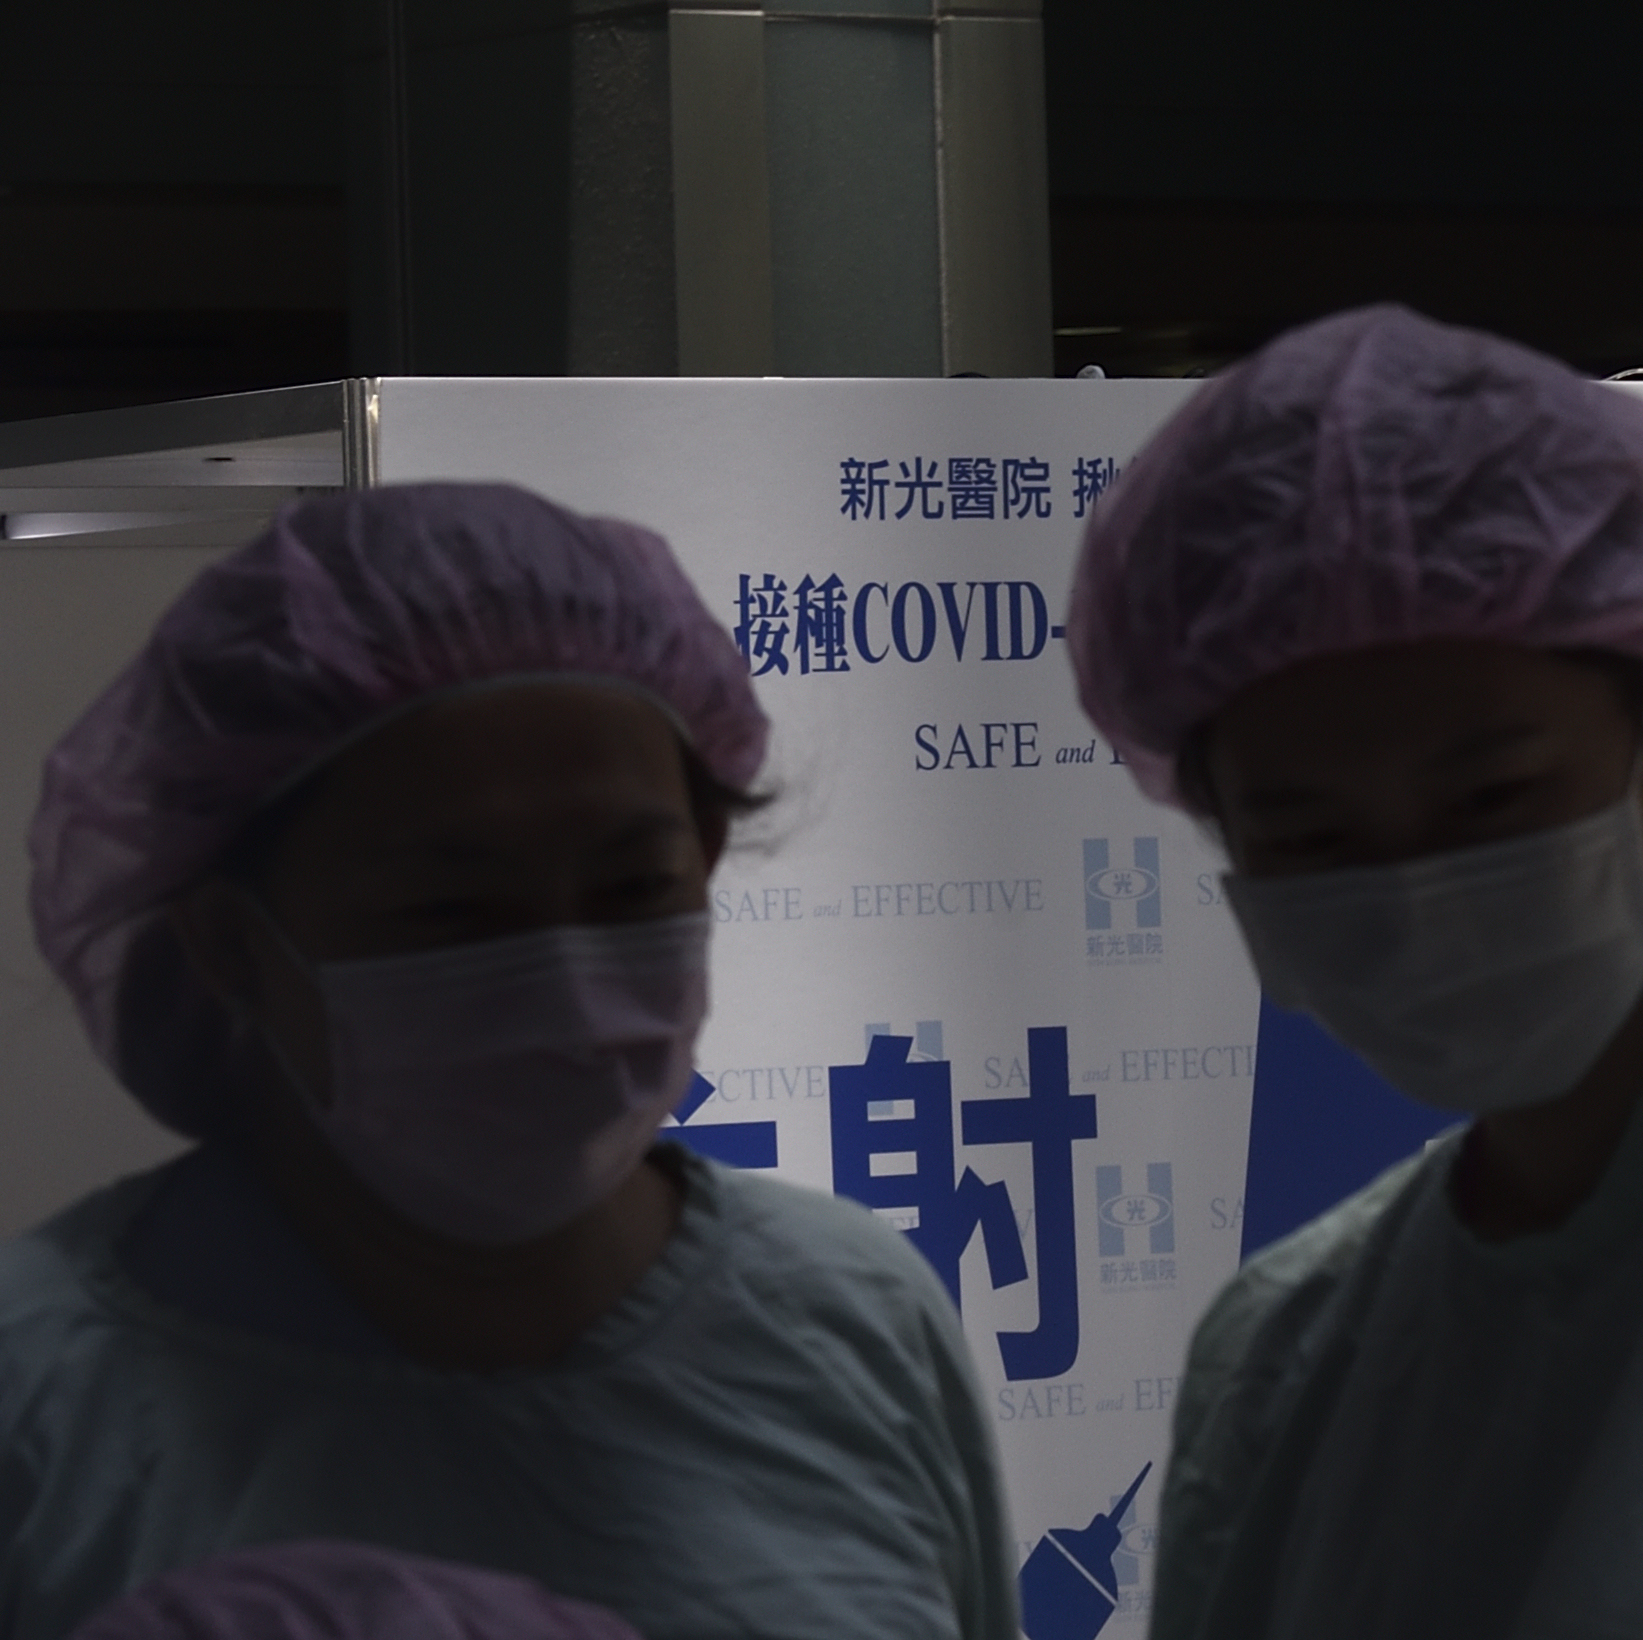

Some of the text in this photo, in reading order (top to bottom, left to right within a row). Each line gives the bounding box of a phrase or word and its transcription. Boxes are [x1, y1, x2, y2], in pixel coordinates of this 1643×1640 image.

[840, 457, 1052, 521] 新光醫院
[733, 573, 1066, 676] 接種COVID-
[914, 722, 1041, 771] SAFE
[1055, 739, 1096, 764] and
[714, 880, 1045, 922] SAFE and EFFECTIVE
[1086, 933, 1163, 956] 新光醫院
[1083, 1063, 1110, 1082] and
[1120, 1046, 1256, 1082] EFFECTI
[711, 1066, 826, 1102] CTIVE
[1100, 1259, 1176, 1283] 新光醫院
[998, 1384, 1086, 1420] SAFE
[1096, 1393, 1124, 1410] and
